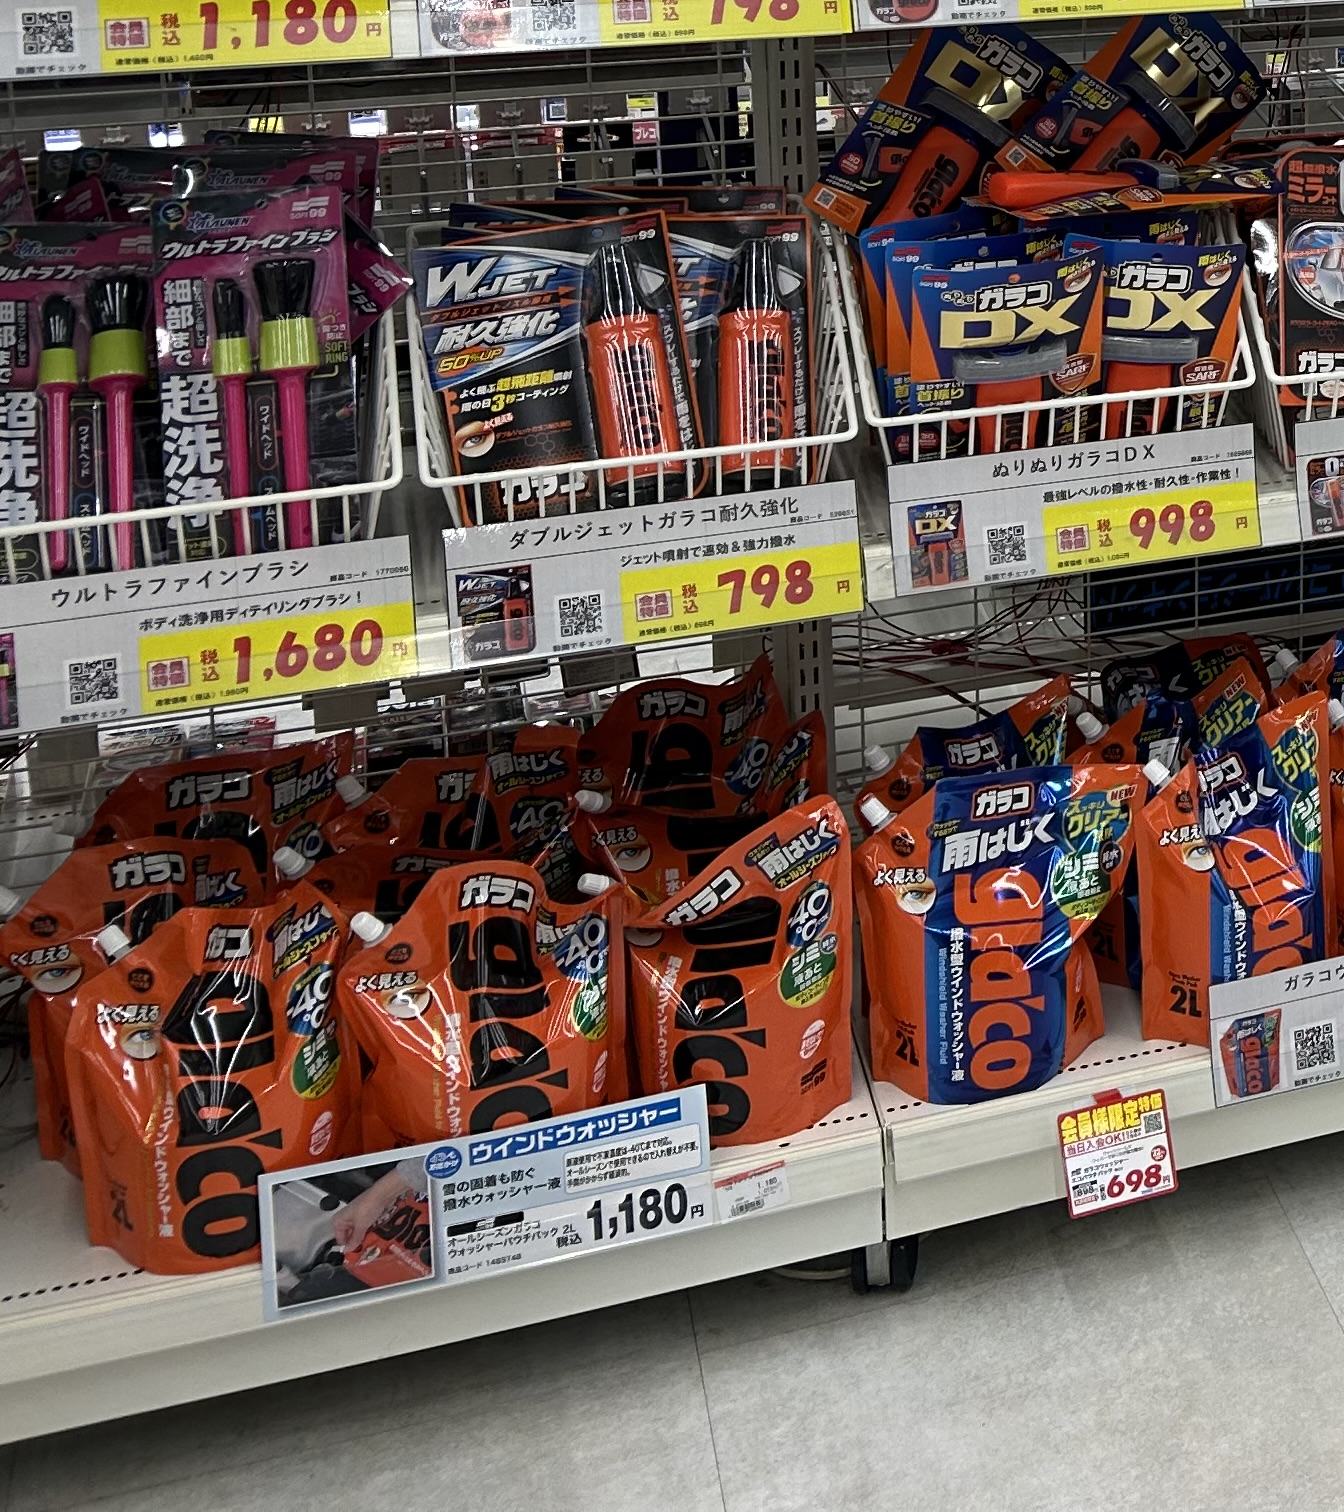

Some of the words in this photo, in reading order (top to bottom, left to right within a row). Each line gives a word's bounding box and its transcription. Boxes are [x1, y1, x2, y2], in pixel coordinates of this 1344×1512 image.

[366, 21, 382, 37] 円
[823, 0, 838, 14] 円
[976, 284, 1052, 311] ガラコ
[433, 310, 562, 354] 耐久強化
[939, 293, 1084, 349] DX
[992, 443, 1157, 478] ぬりぬりガラコDX
[509, 497, 800, 551] ダブルジェットガラコ耐久強化
[1129, 500, 1216, 549] 998
[51, 561, 310, 608] ウルトラファインブラシ
[717, 559, 815, 616] 798
[232, 618, 384, 685] 1,680
[973, 784, 1034, 818] ガラコ
[756, 817, 841, 877] 雨はじく
[941, 812, 1055, 873] 雨はじく
[460, 874, 535, 910] ガラコ
[872, 866, 927, 886] よく見える
[355, 971, 417, 993] よく見える
[1169, 986, 1202, 1017] 2L
[470, 1102, 679, 1163] ウインドウォッシャー
[1107, 1164, 1162, 1198] 698
[586, 1182, 688, 1241] 1,180
[690, 1204, 704, 1218] 円
